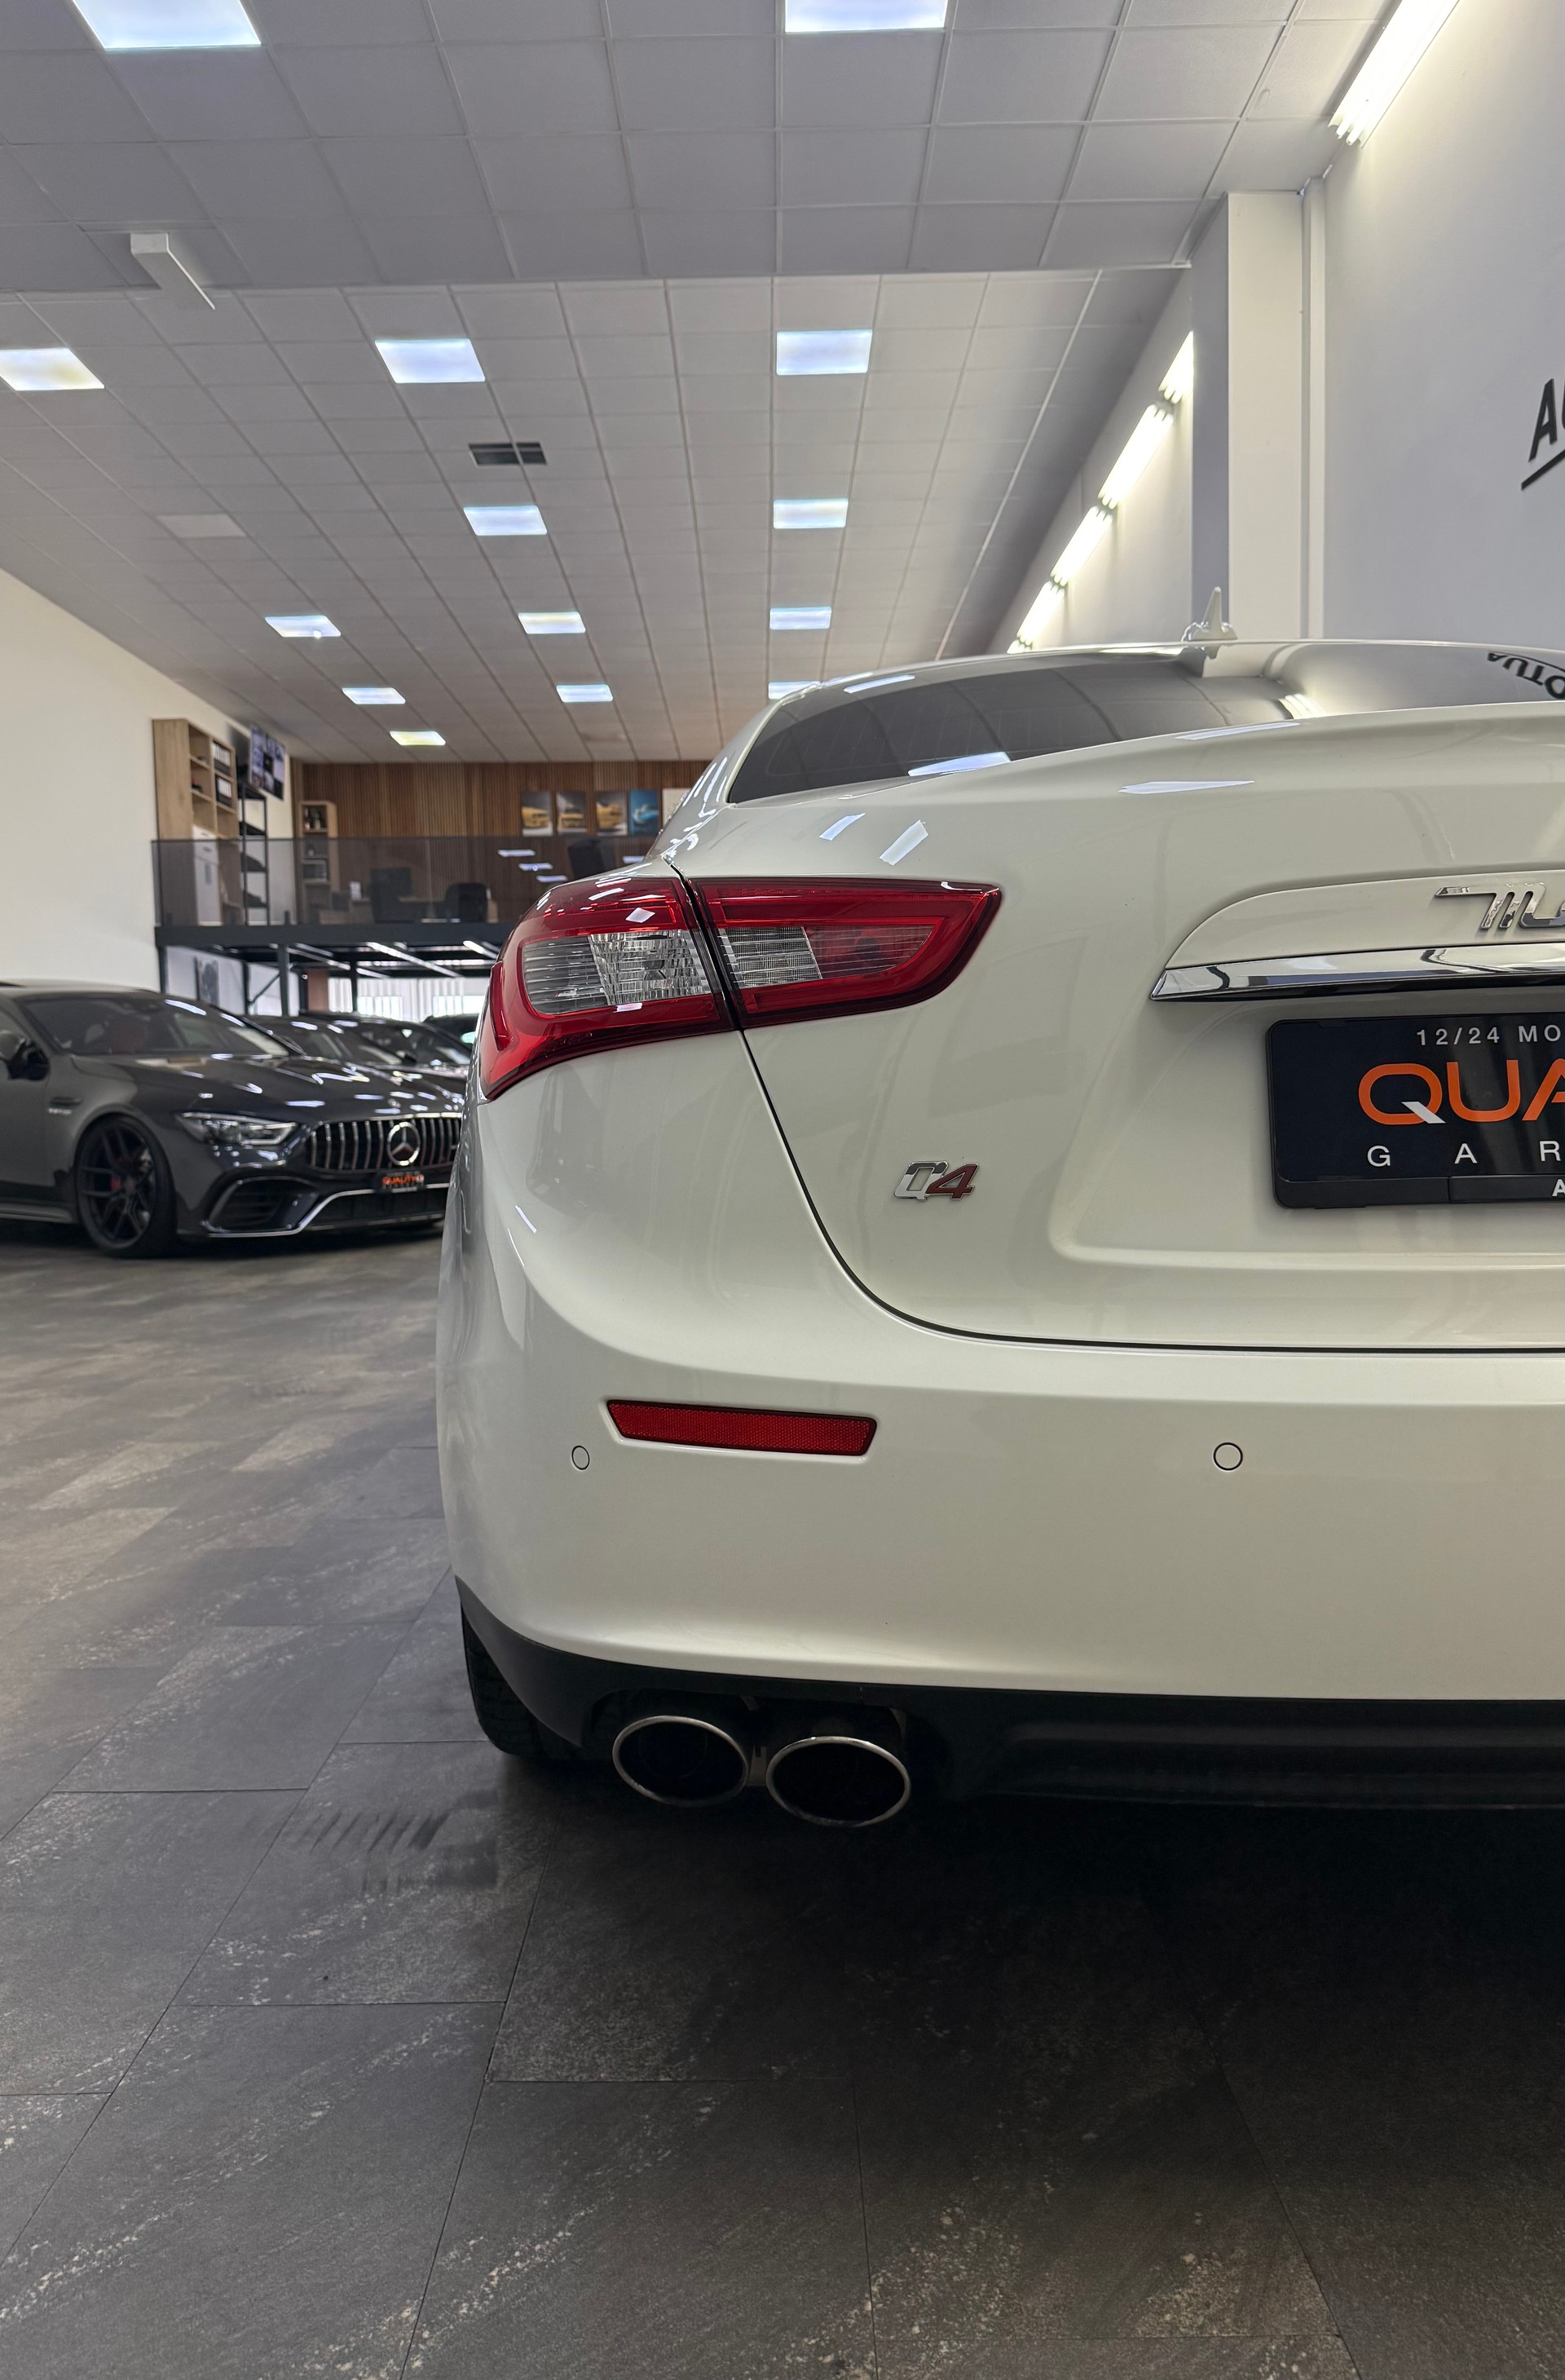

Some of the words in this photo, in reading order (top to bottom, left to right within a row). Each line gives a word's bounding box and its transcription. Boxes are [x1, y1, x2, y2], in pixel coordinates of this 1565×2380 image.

[1528, 378, 1565, 463] A
[1435, 881, 1565, 928] M
[1417, 1027, 1499, 1045] 12/24
[1519, 1025, 1561, 1043] MO
[1367, 1141, 1561, 1167] GAR
[894, 1161, 979, 1201] Q4
